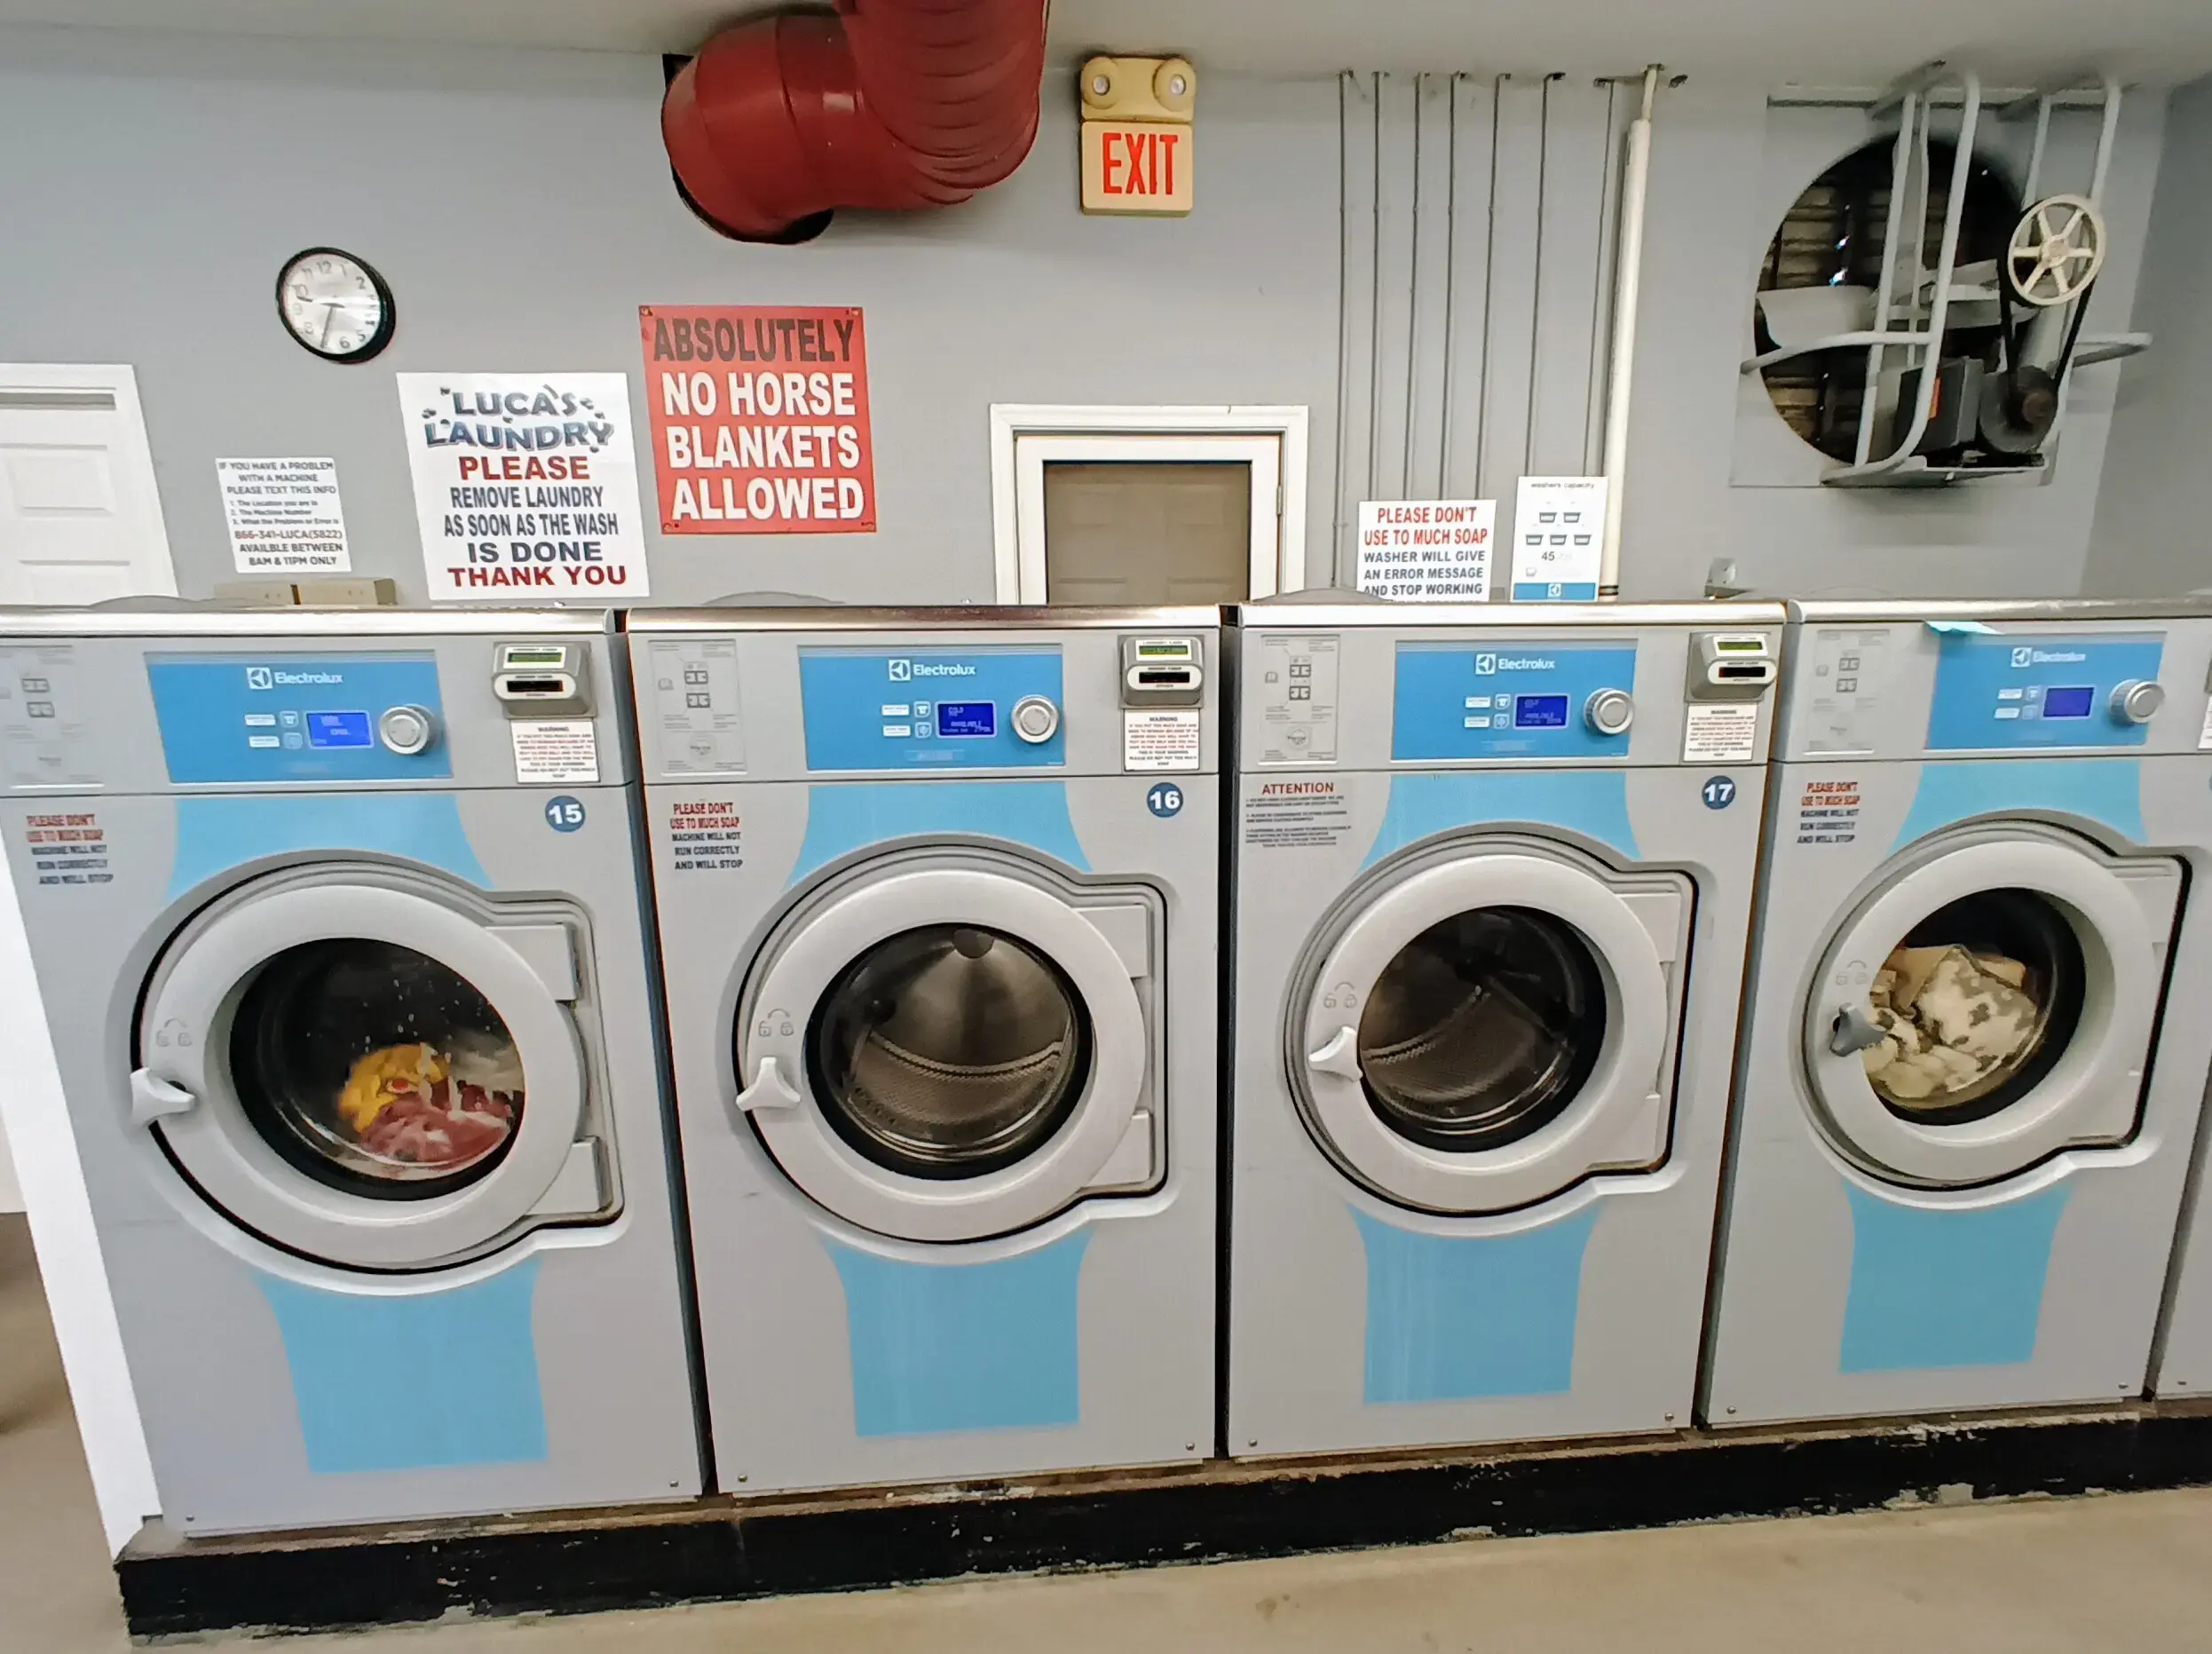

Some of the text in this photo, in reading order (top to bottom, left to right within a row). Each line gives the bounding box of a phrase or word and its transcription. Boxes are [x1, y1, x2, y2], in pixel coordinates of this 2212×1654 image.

[1102, 132, 1178, 194] EXIT
[316, 260, 332, 274] 12
[356, 276, 367, 289] 2
[339, 336, 351, 348] 6
[653, 317, 854, 362] ABSOLUTELY
[453, 384, 577, 416] LUCA'S
[661, 371, 856, 416] NO HORSE
[424, 421, 615, 451] LAUNDRY
[666, 424, 860, 469] BLANKETS
[252, 462, 277, 471] HAVE
[459, 455, 590, 480] PLEASE
[238, 473, 265, 482] WITH
[275, 473, 319, 482] MACHINE
[227, 486, 263, 495] PLEASE
[265, 486, 288, 495] TEXT
[450, 486, 604, 508] REMOVE LAUNDRY
[672, 477, 865, 520] ALLOWED
[1378, 506, 1477, 524] PLEASE DON'T
[444, 513, 619, 537] AS SOON AS THE WASH
[1364, 527, 1488, 546] USE TO MUCH SOAP
[291, 542, 344, 552] BETWEEN
[468, 542, 603, 563] IS DONE
[309, 556, 337, 566] ONLY
[1364, 550, 1485, 563] WASHER WILL GIVE
[1541, 551, 1555, 561] 45
[447, 566, 627, 587] THANK YOU
[1364, 567, 1483, 580] AN ERROR MESSAGE
[1392, 584, 1421, 596] STOP
[1426, 583, 1482, 595] WORKING
[912, 664, 976, 677] Electrolux
[1498, 658, 1555, 670] Electrolux
[273, 672, 344, 685] Electrolux
[1262, 782, 1334, 795] ATTENTION
[1704, 783, 1733, 802] 17
[1149, 790, 1180, 810] 16
[549, 803, 582, 825] 15
[674, 802, 733, 814] PLEASE DON'T
[670, 818, 684, 829] USE
[686, 818, 696, 829] TO
[698, 817, 719, 828] MUCH
[675, 845, 739, 856] RUN CORRECTLY
[675, 859, 743, 869] AND WILL STOP
